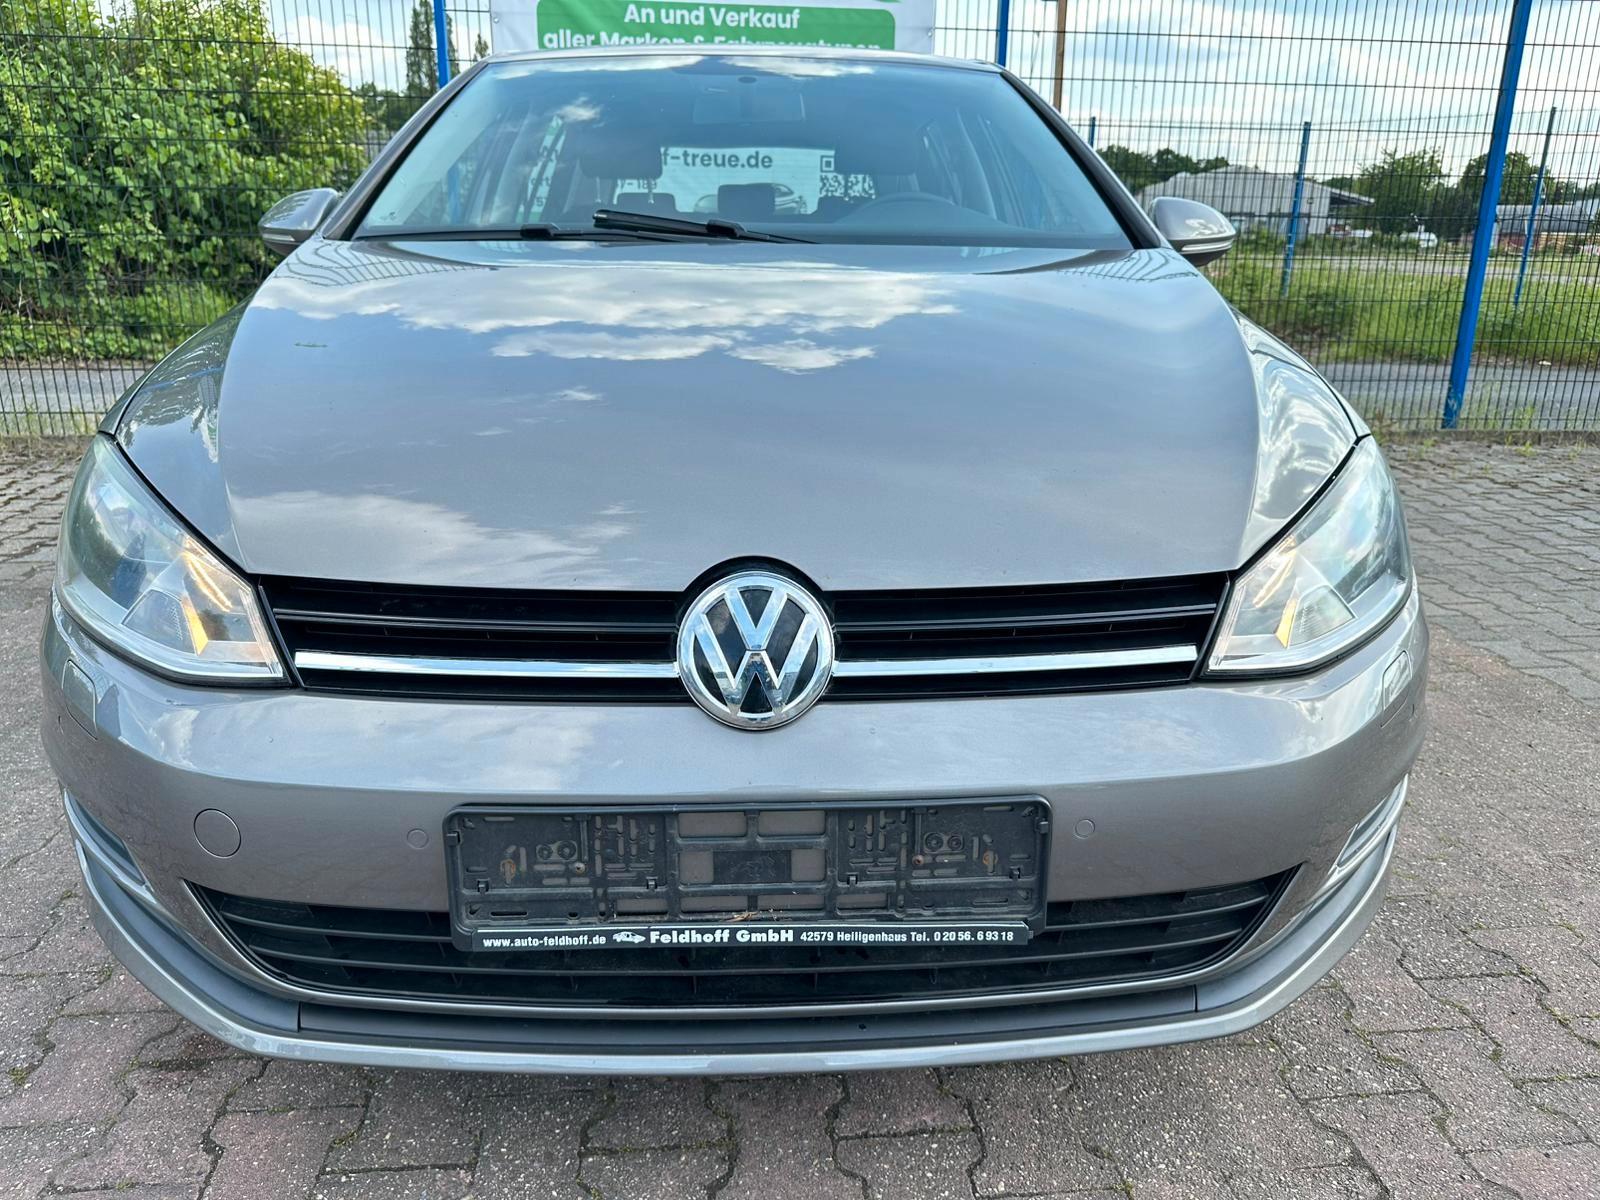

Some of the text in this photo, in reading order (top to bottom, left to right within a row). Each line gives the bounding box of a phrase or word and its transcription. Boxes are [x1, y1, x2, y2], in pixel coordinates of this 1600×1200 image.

[624, 4, 801, 29] An und Verkauf
[543, 29, 595, 49] aller
[689, 584, 823, 717] VW
[483, 934, 607, 948] www.auto-feldhoff.de
[650, 929, 730, 944] Feldhoff
[736, 928, 794, 943] GmbH
[800, 931, 834, 942] 42579
[837, 930, 907, 944] Heiligenhaus
[910, 931, 930, 942] Tel.
